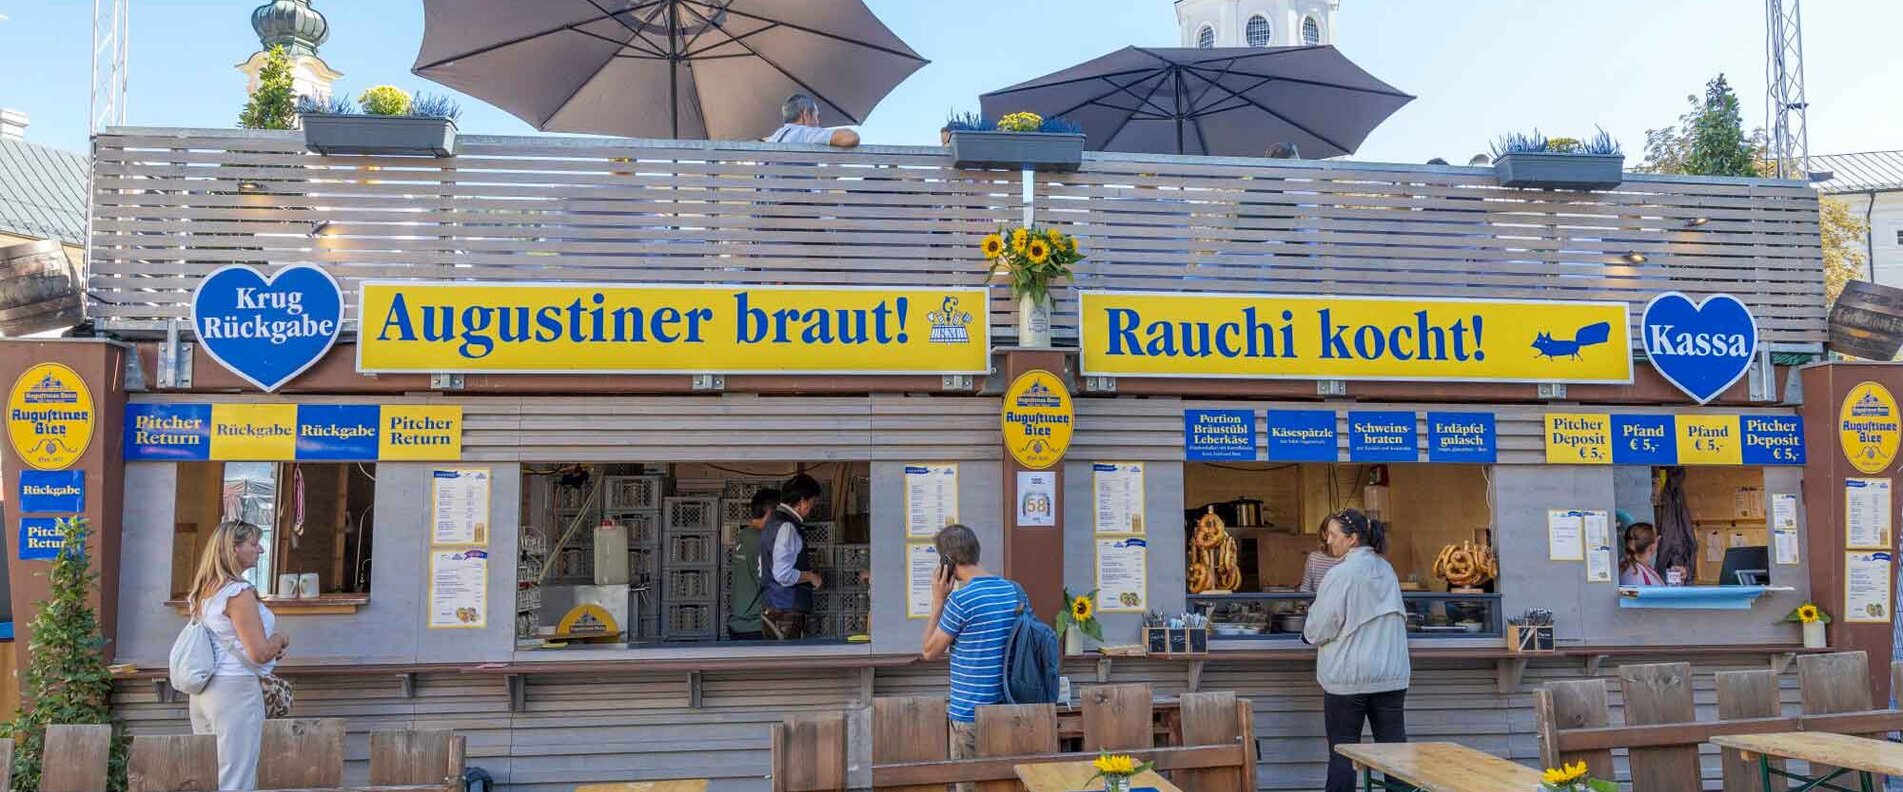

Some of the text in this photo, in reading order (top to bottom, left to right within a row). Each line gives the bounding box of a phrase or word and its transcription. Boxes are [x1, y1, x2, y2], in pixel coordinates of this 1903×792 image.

[236, 287, 303, 315] Krug
[203, 314, 334, 344] Rückgabe
[377, 291, 908, 359] Augustiner braut!
[1104, 306, 1485, 361] Rauchi kocht!
[1649, 324, 1749, 357] Kassa
[135, 415, 203, 429] Pitcher
[390, 416, 453, 430] Pitcher
[1200, 414, 1241, 423] Portion
[1553, 418, 1604, 430] Pitcher
[1747, 419, 1797, 432] Pitcher
[35, 422, 66, 438] Bier
[216, 423, 292, 438] Rückgabe
[301, 424, 376, 439] Rückgabe
[1025, 424, 1051, 438] Bier
[1194, 424, 1248, 434] Bräustübl
[1272, 427, 1333, 439] Käsespätzle
[1354, 423, 1412, 433] Schweins-
[1436, 423, 1487, 435] Erdäpfel-
[1622, 424, 1665, 437] Pfand
[1688, 425, 1728, 438] Pfand
[135, 431, 200, 445] Return
[390, 432, 451, 445] Return
[1194, 435, 1249, 444] Leberkäse
[1364, 434, 1403, 444] braten
[1440, 435, 1483, 447] gulasch
[1553, 432, 1605, 447] Deposit
[1746, 434, 1800, 448] Deposit
[1630, 439, 1660, 453] € 5,-
[1695, 439, 1724, 453] € 5,-
[1579, 447, 1606, 460] € 5,-
[1773, 448, 1799, 462] € 5,-
[23, 485, 81, 497] Rückgabe
[1027, 498, 1046, 512] 58
[27, 526, 66, 537] Pitch
[28, 538, 66, 548] Retur
